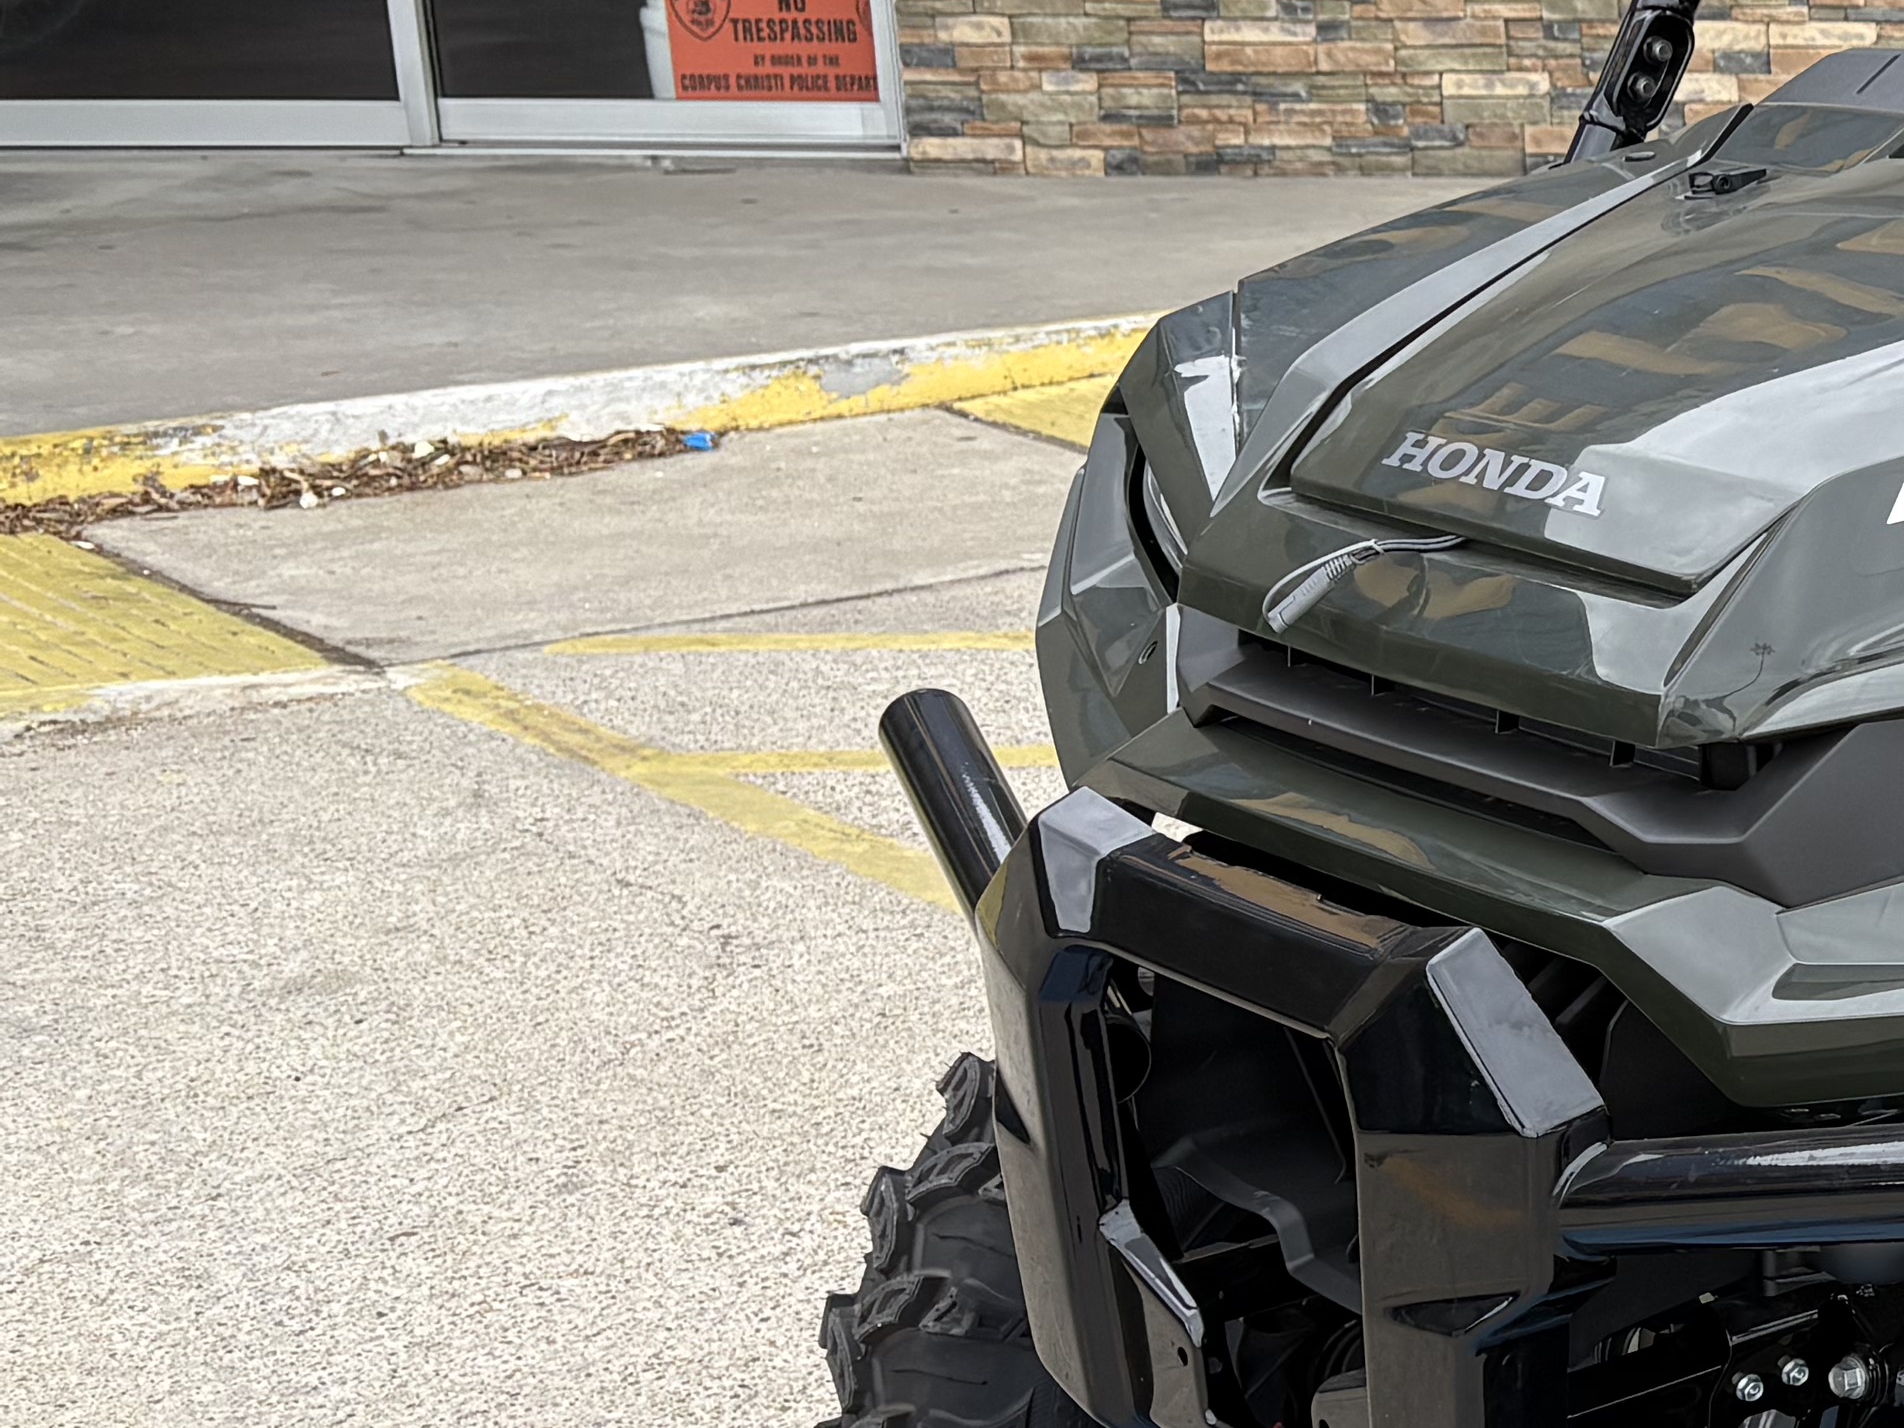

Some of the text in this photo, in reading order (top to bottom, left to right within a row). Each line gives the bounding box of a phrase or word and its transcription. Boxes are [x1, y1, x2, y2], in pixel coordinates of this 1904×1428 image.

[732, 18, 858, 42] TRESPASSING
[680, 74, 730, 92] CORPUS
[736, 74, 784, 92] CHRISTI
[789, 74, 831, 92] POLICE
[1381, 430, 1605, 517] HONDA
